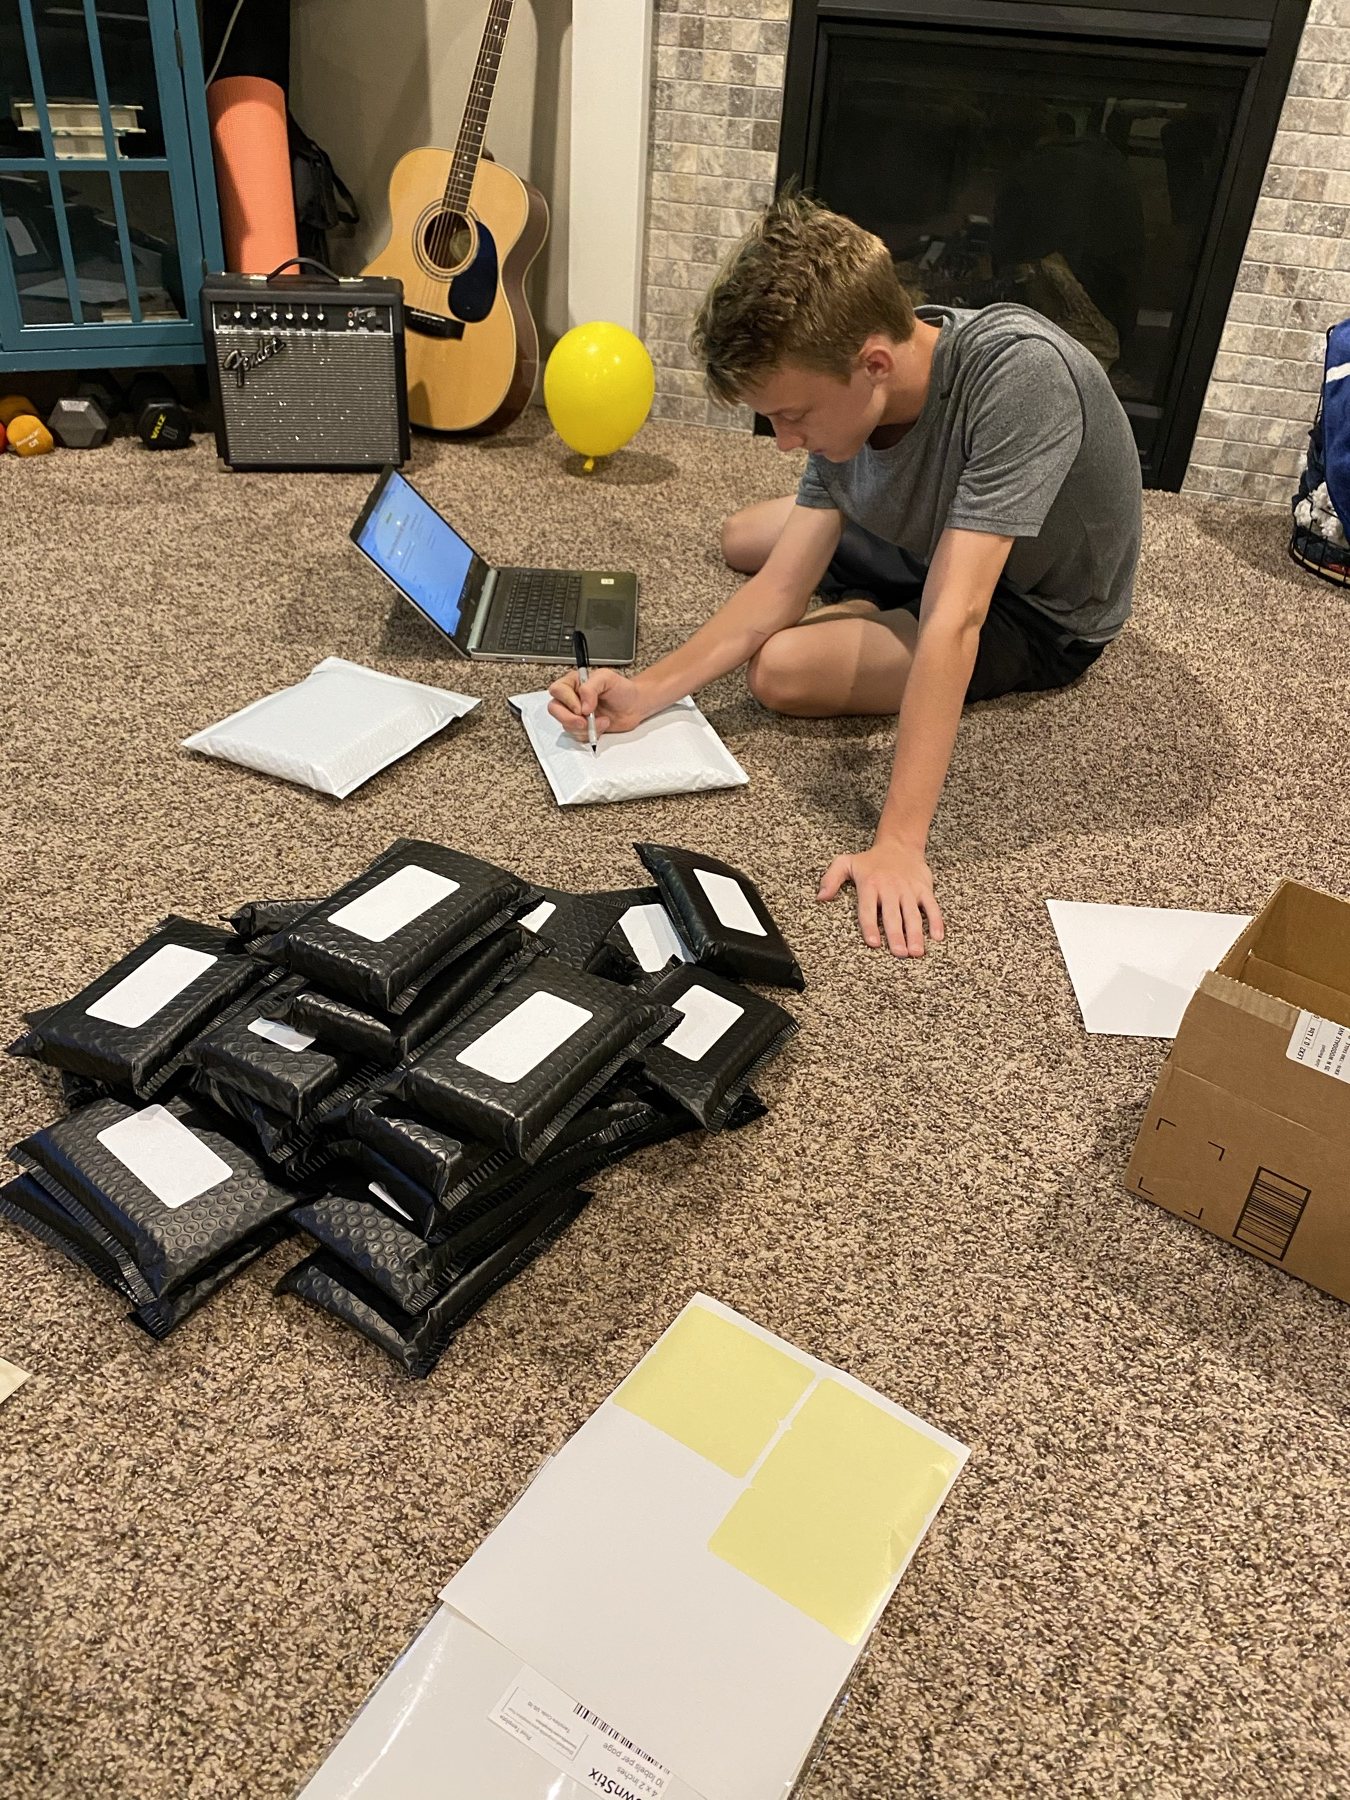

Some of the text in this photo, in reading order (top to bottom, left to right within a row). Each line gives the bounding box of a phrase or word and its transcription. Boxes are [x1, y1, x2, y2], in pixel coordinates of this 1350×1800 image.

[223, 337, 287, 388] Fender
[150, 414, 167, 439] ZIVA
[602, 1742, 622, 1757] page
[621, 1755, 635, 1766] per
[634, 1763, 656, 1784] labels
[638, 1781, 645, 1790] 2
[652, 1789, 658, 1797] 4
